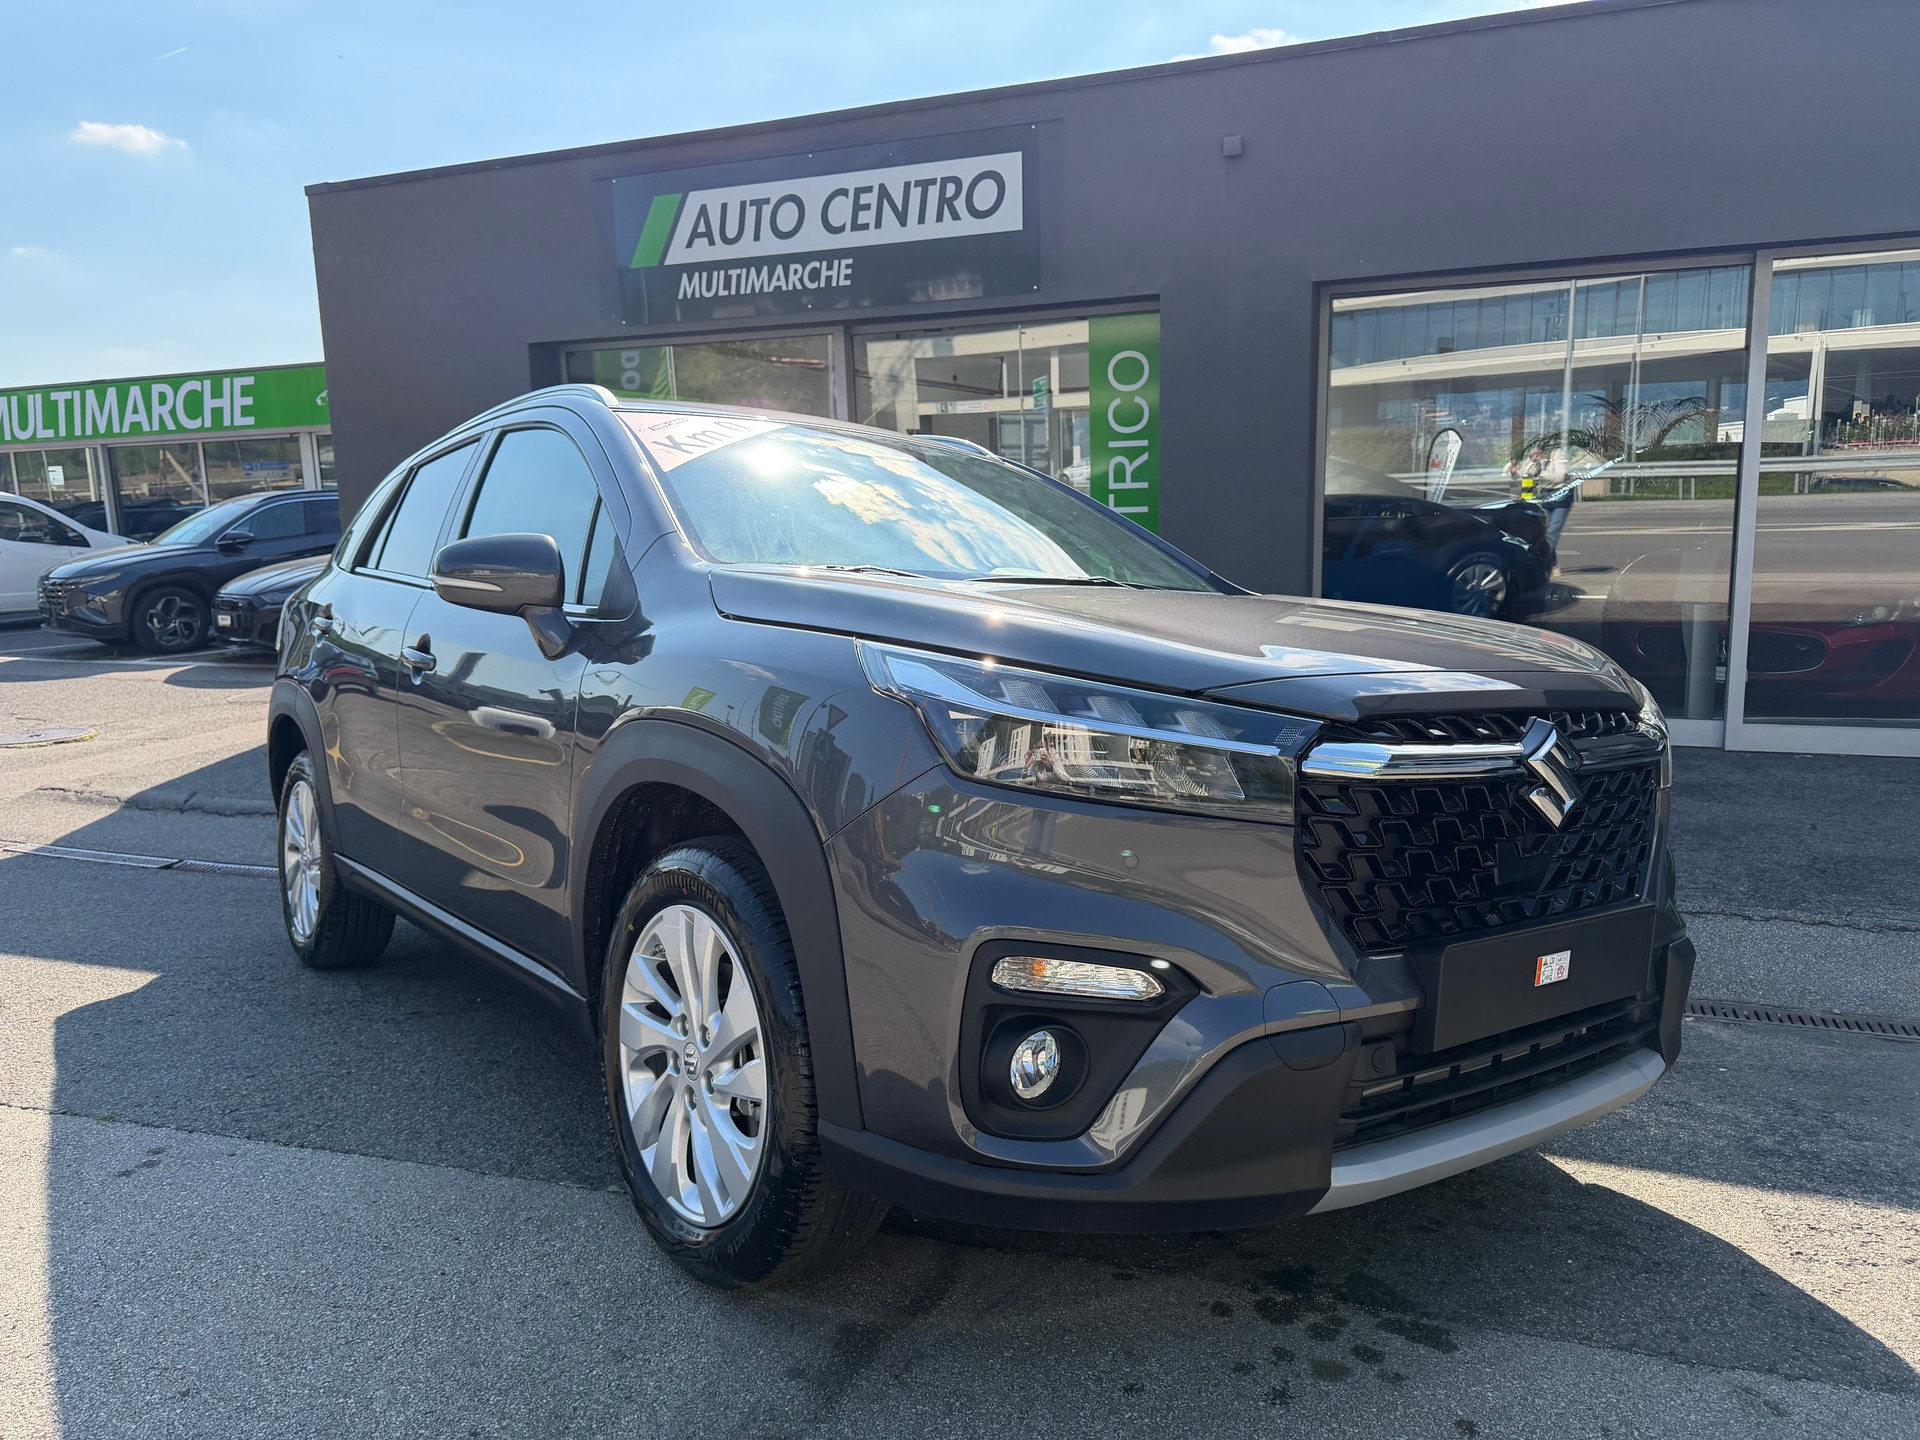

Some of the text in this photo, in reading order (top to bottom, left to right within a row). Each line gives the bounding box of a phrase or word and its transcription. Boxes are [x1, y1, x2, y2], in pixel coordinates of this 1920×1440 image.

[685, 170, 1006, 249] AUTO CENTRO
[678, 258, 853, 299] MULTIMARCHE
[651, 430, 733, 454] Km
